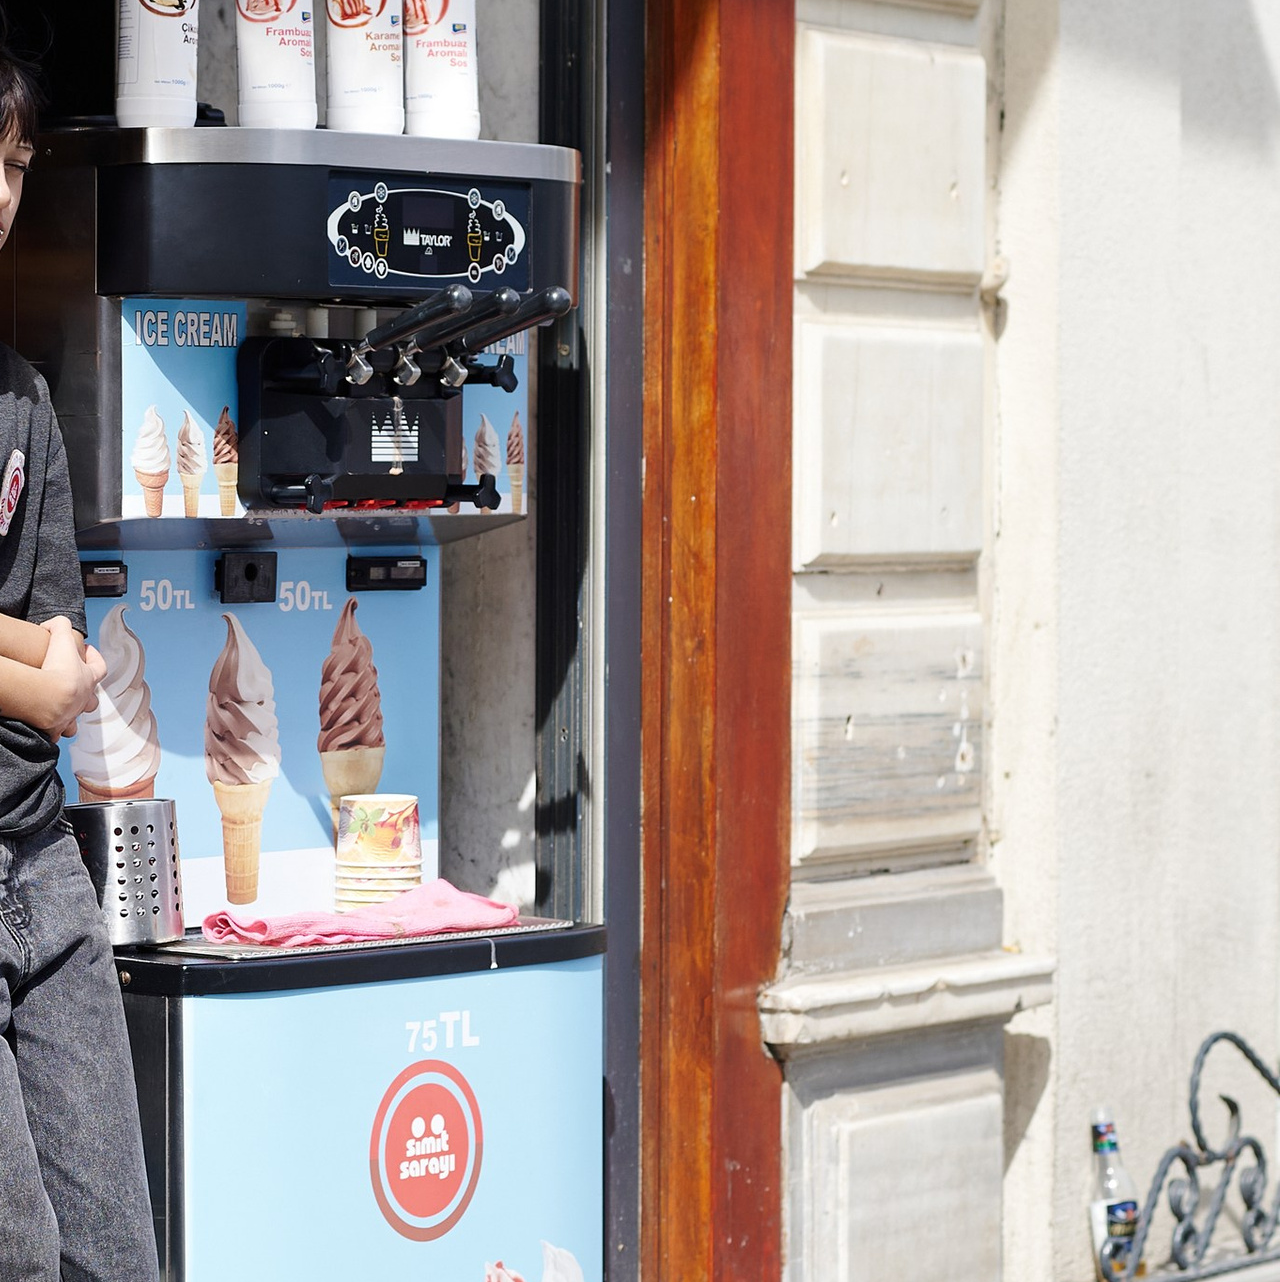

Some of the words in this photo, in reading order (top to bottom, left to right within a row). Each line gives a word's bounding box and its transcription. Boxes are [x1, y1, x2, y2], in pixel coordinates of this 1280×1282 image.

[415, 39, 468, 49] Frambuaz
[420, 233, 451, 247] TAYLOR
[134, 310, 170, 347] ICE
[173, 311, 238, 348] CREAM
[406, 1121, 449, 1158] simit
[399, 1153, 456, 1180] sarayı
